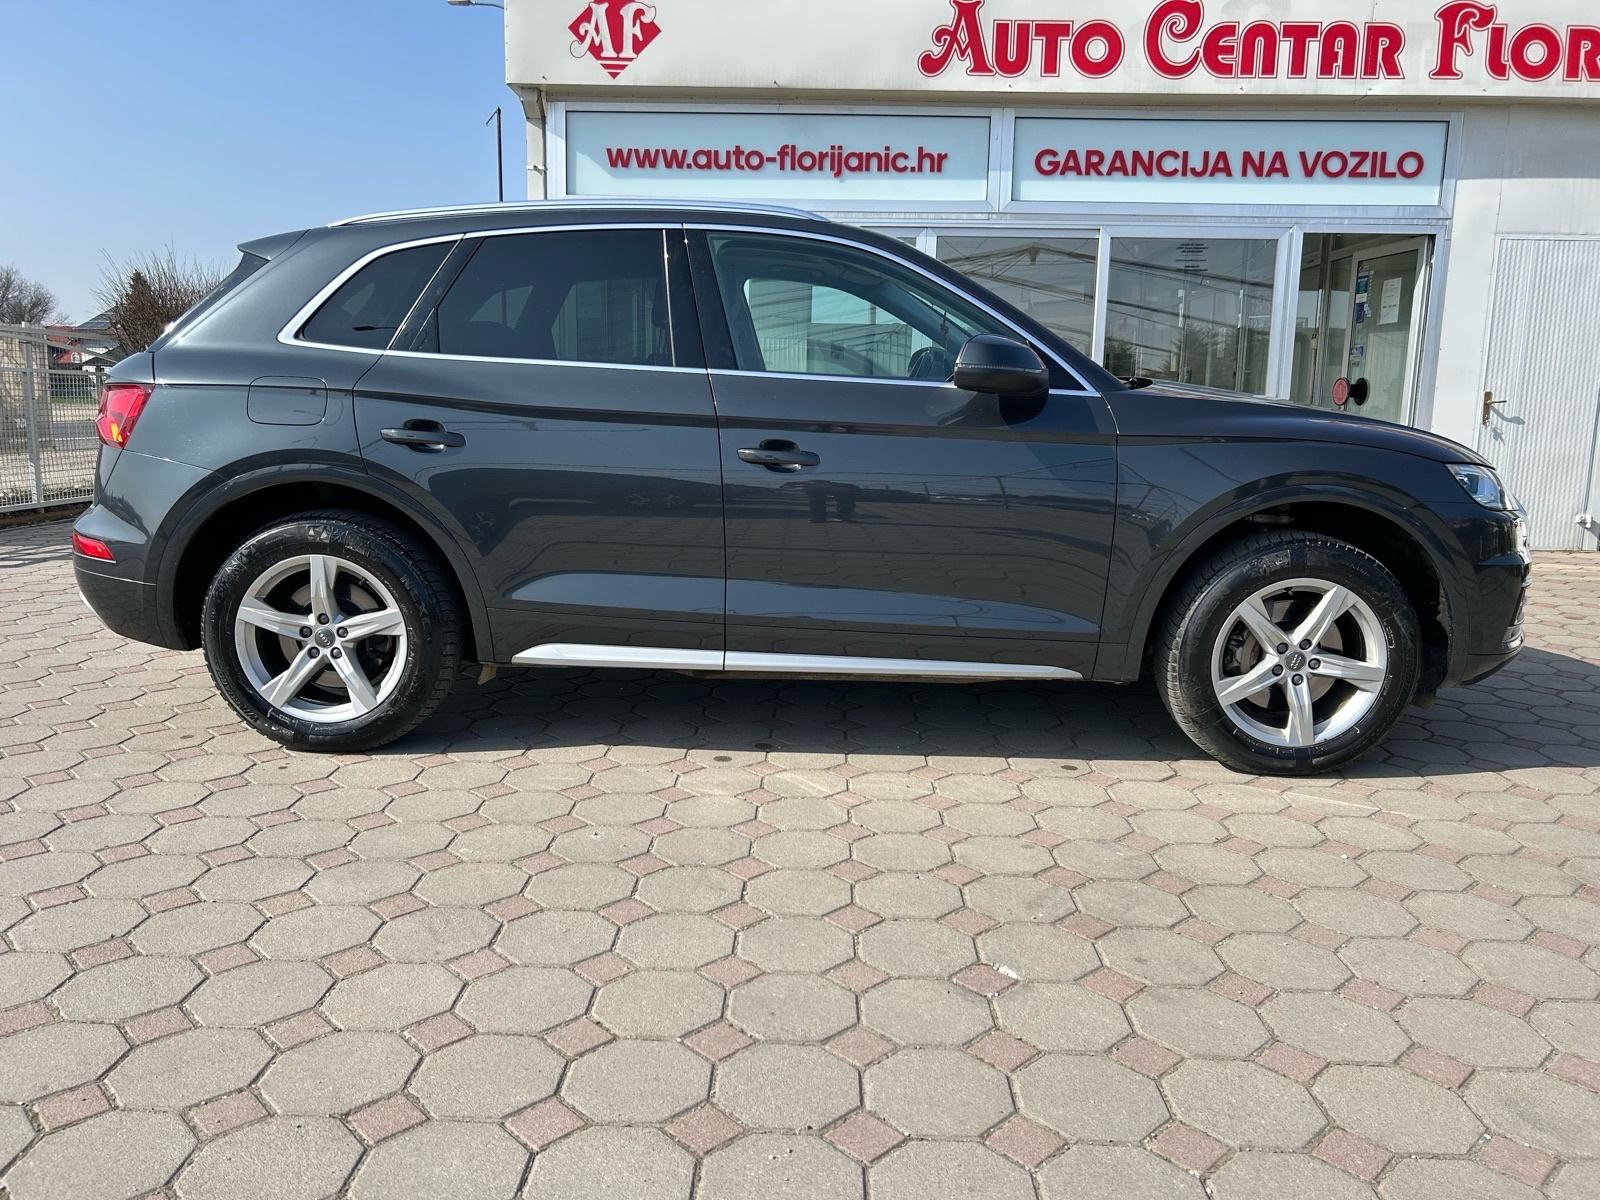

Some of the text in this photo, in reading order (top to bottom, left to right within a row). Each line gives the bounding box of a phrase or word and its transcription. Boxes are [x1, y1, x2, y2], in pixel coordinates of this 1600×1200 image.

[570, 1, 657, 58] AF
[918, 0, 1126, 79] AUTO
[1142, 0, 1405, 80] CENTAR
[606, 144, 948, 178] www.auto-florijanic.hr
[1034, 149, 1424, 179] GARANCIJA NA VOZILO
